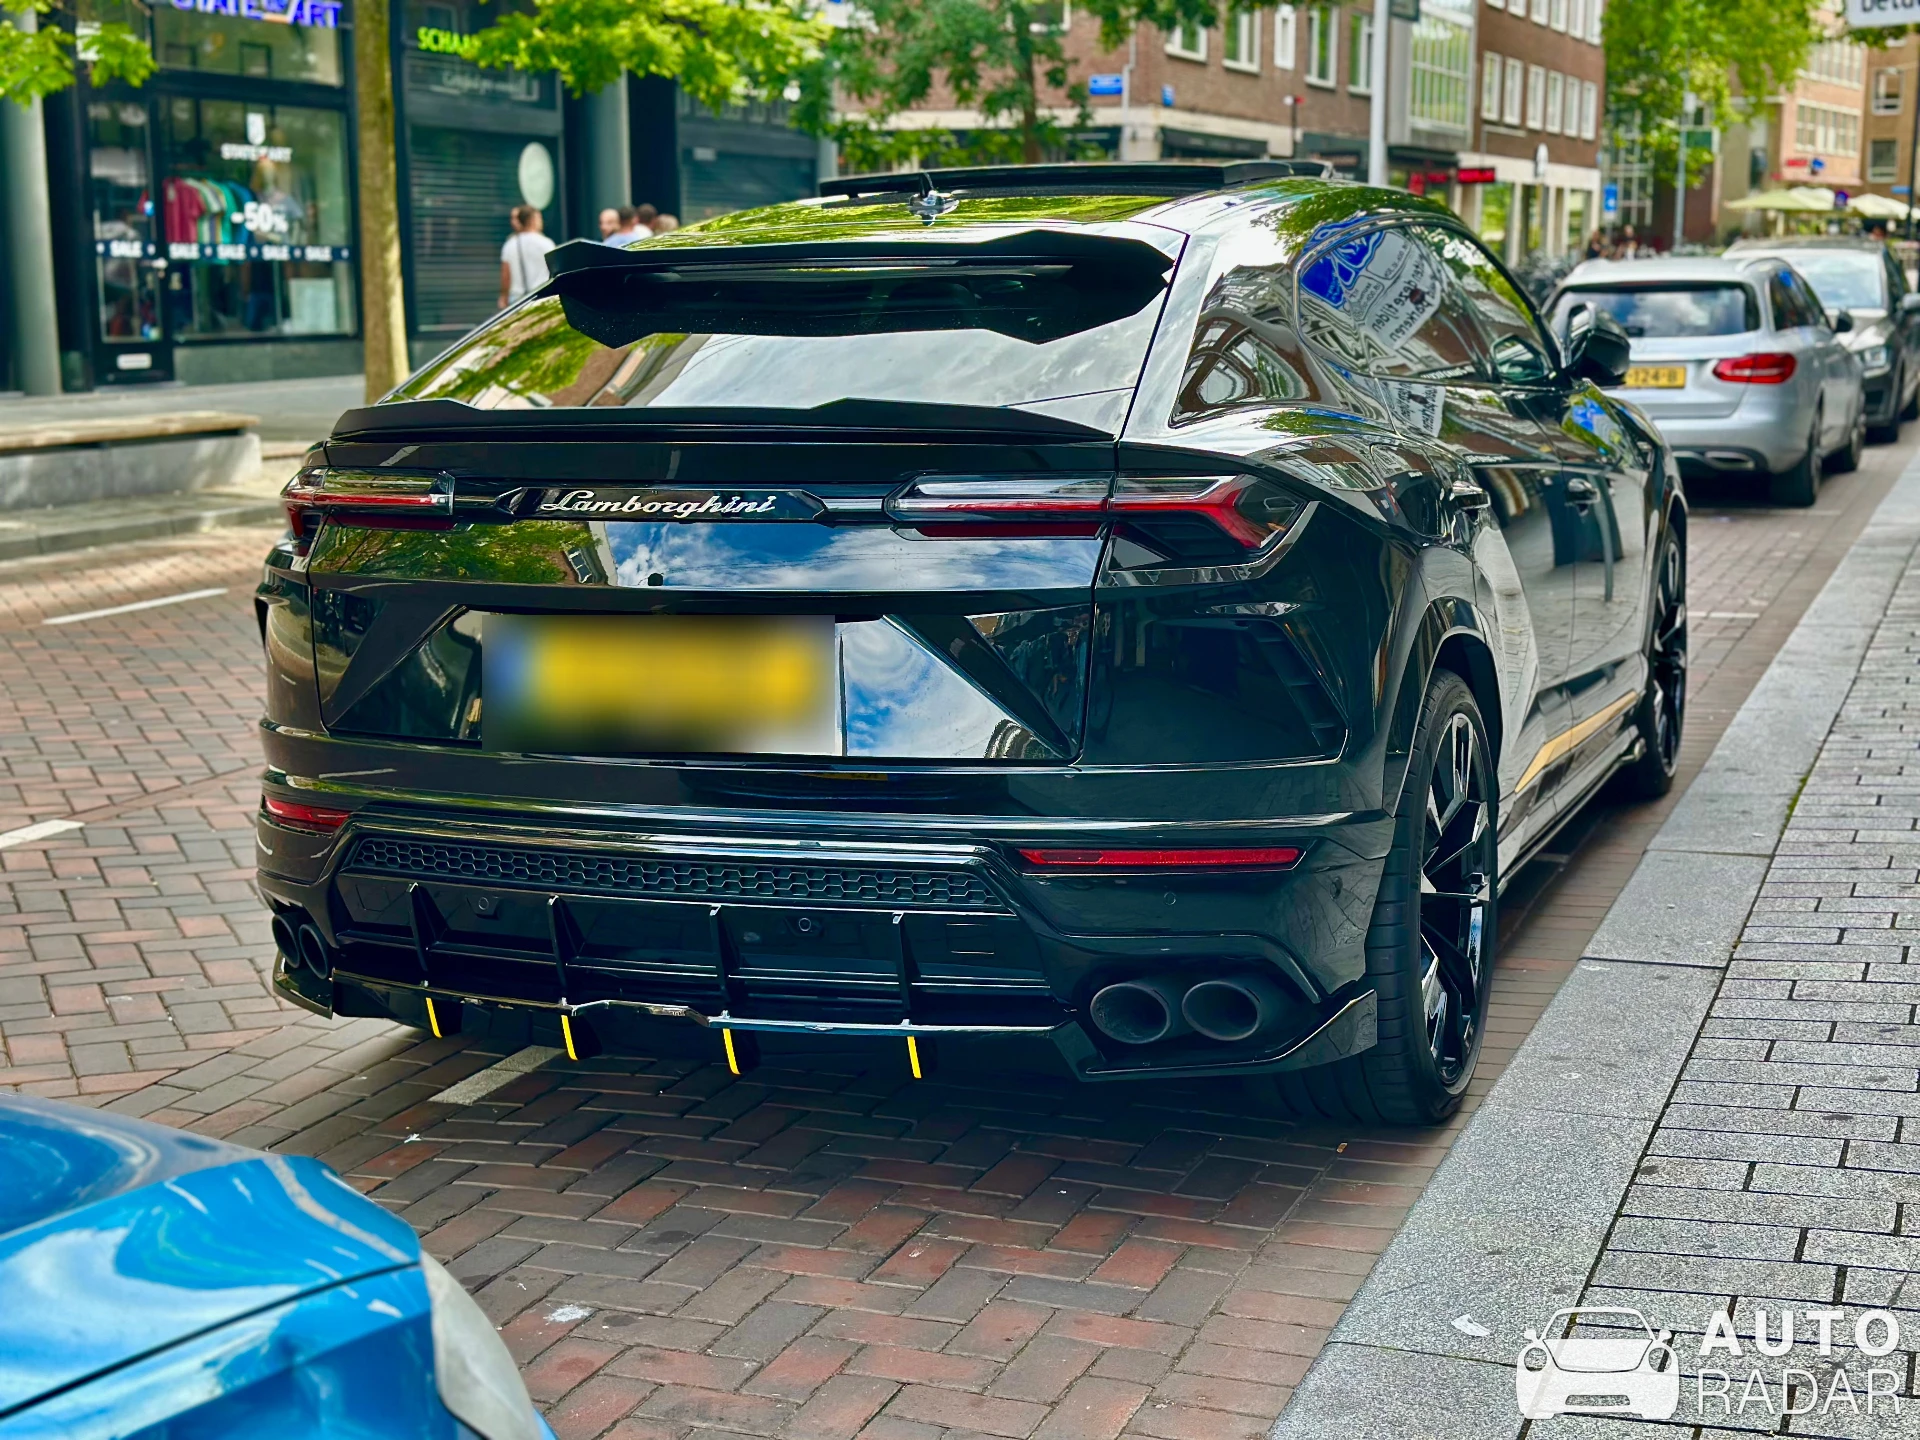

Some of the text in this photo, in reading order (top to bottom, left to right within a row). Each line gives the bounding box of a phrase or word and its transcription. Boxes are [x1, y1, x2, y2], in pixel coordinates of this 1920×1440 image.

[289, 0, 343, 28] ART
[220, 142, 258, 161] STATE
[230, 201, 289, 233] -50%
[110, 241, 143, 257] SALE
[169, 243, 333, 261] SALE SALE SALE SALE
[539, 489, 777, 519] Lamborghini
